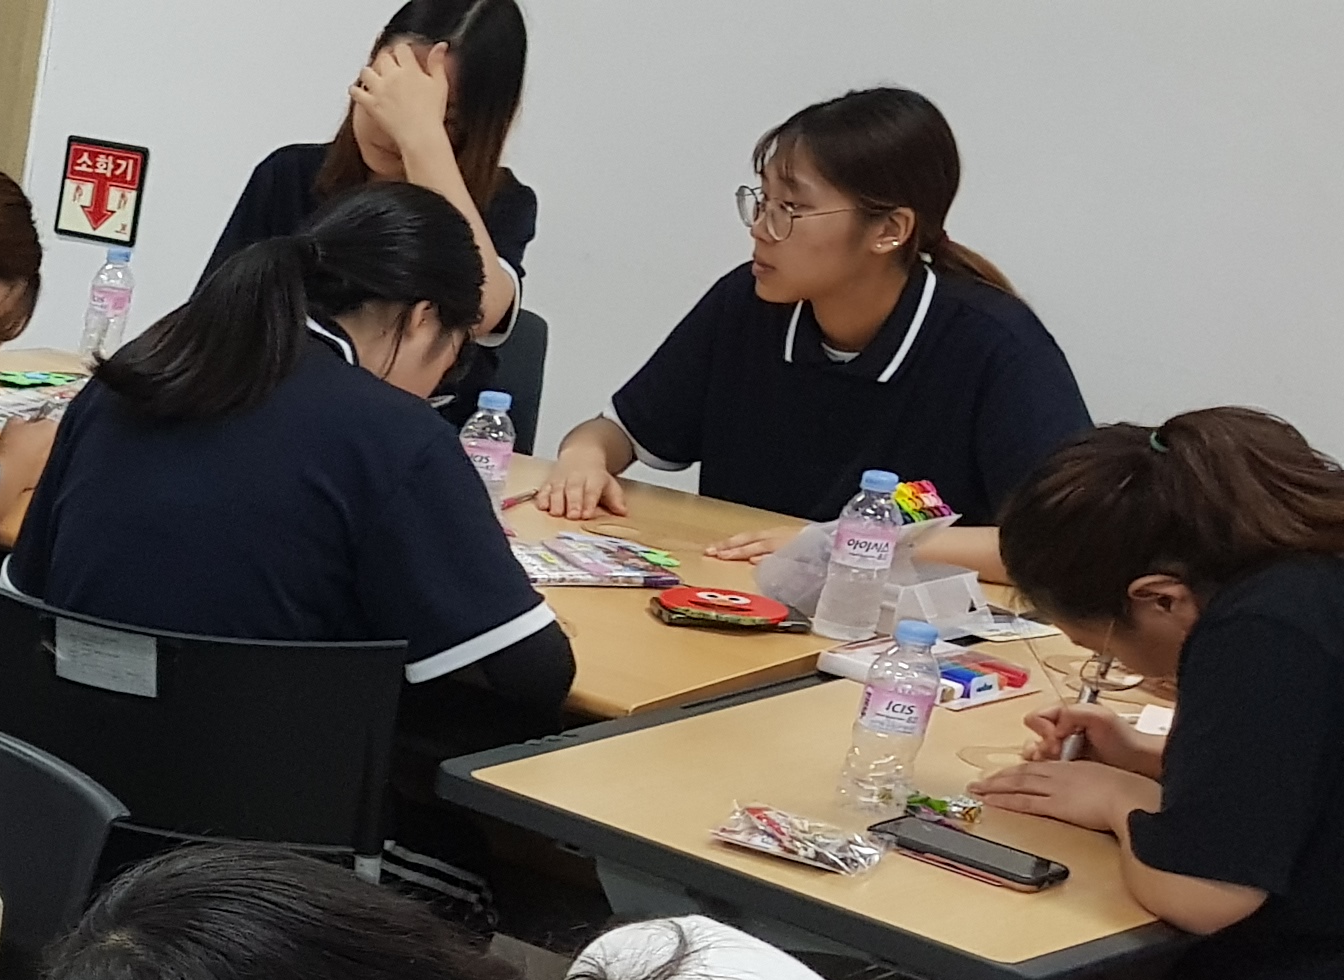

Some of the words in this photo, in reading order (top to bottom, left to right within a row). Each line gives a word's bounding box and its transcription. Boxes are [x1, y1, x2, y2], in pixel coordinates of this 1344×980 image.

[73, 151, 134, 182] 소화기
[846, 538, 890, 553] 아이시스
[885, 700, 916, 715] ICIS
